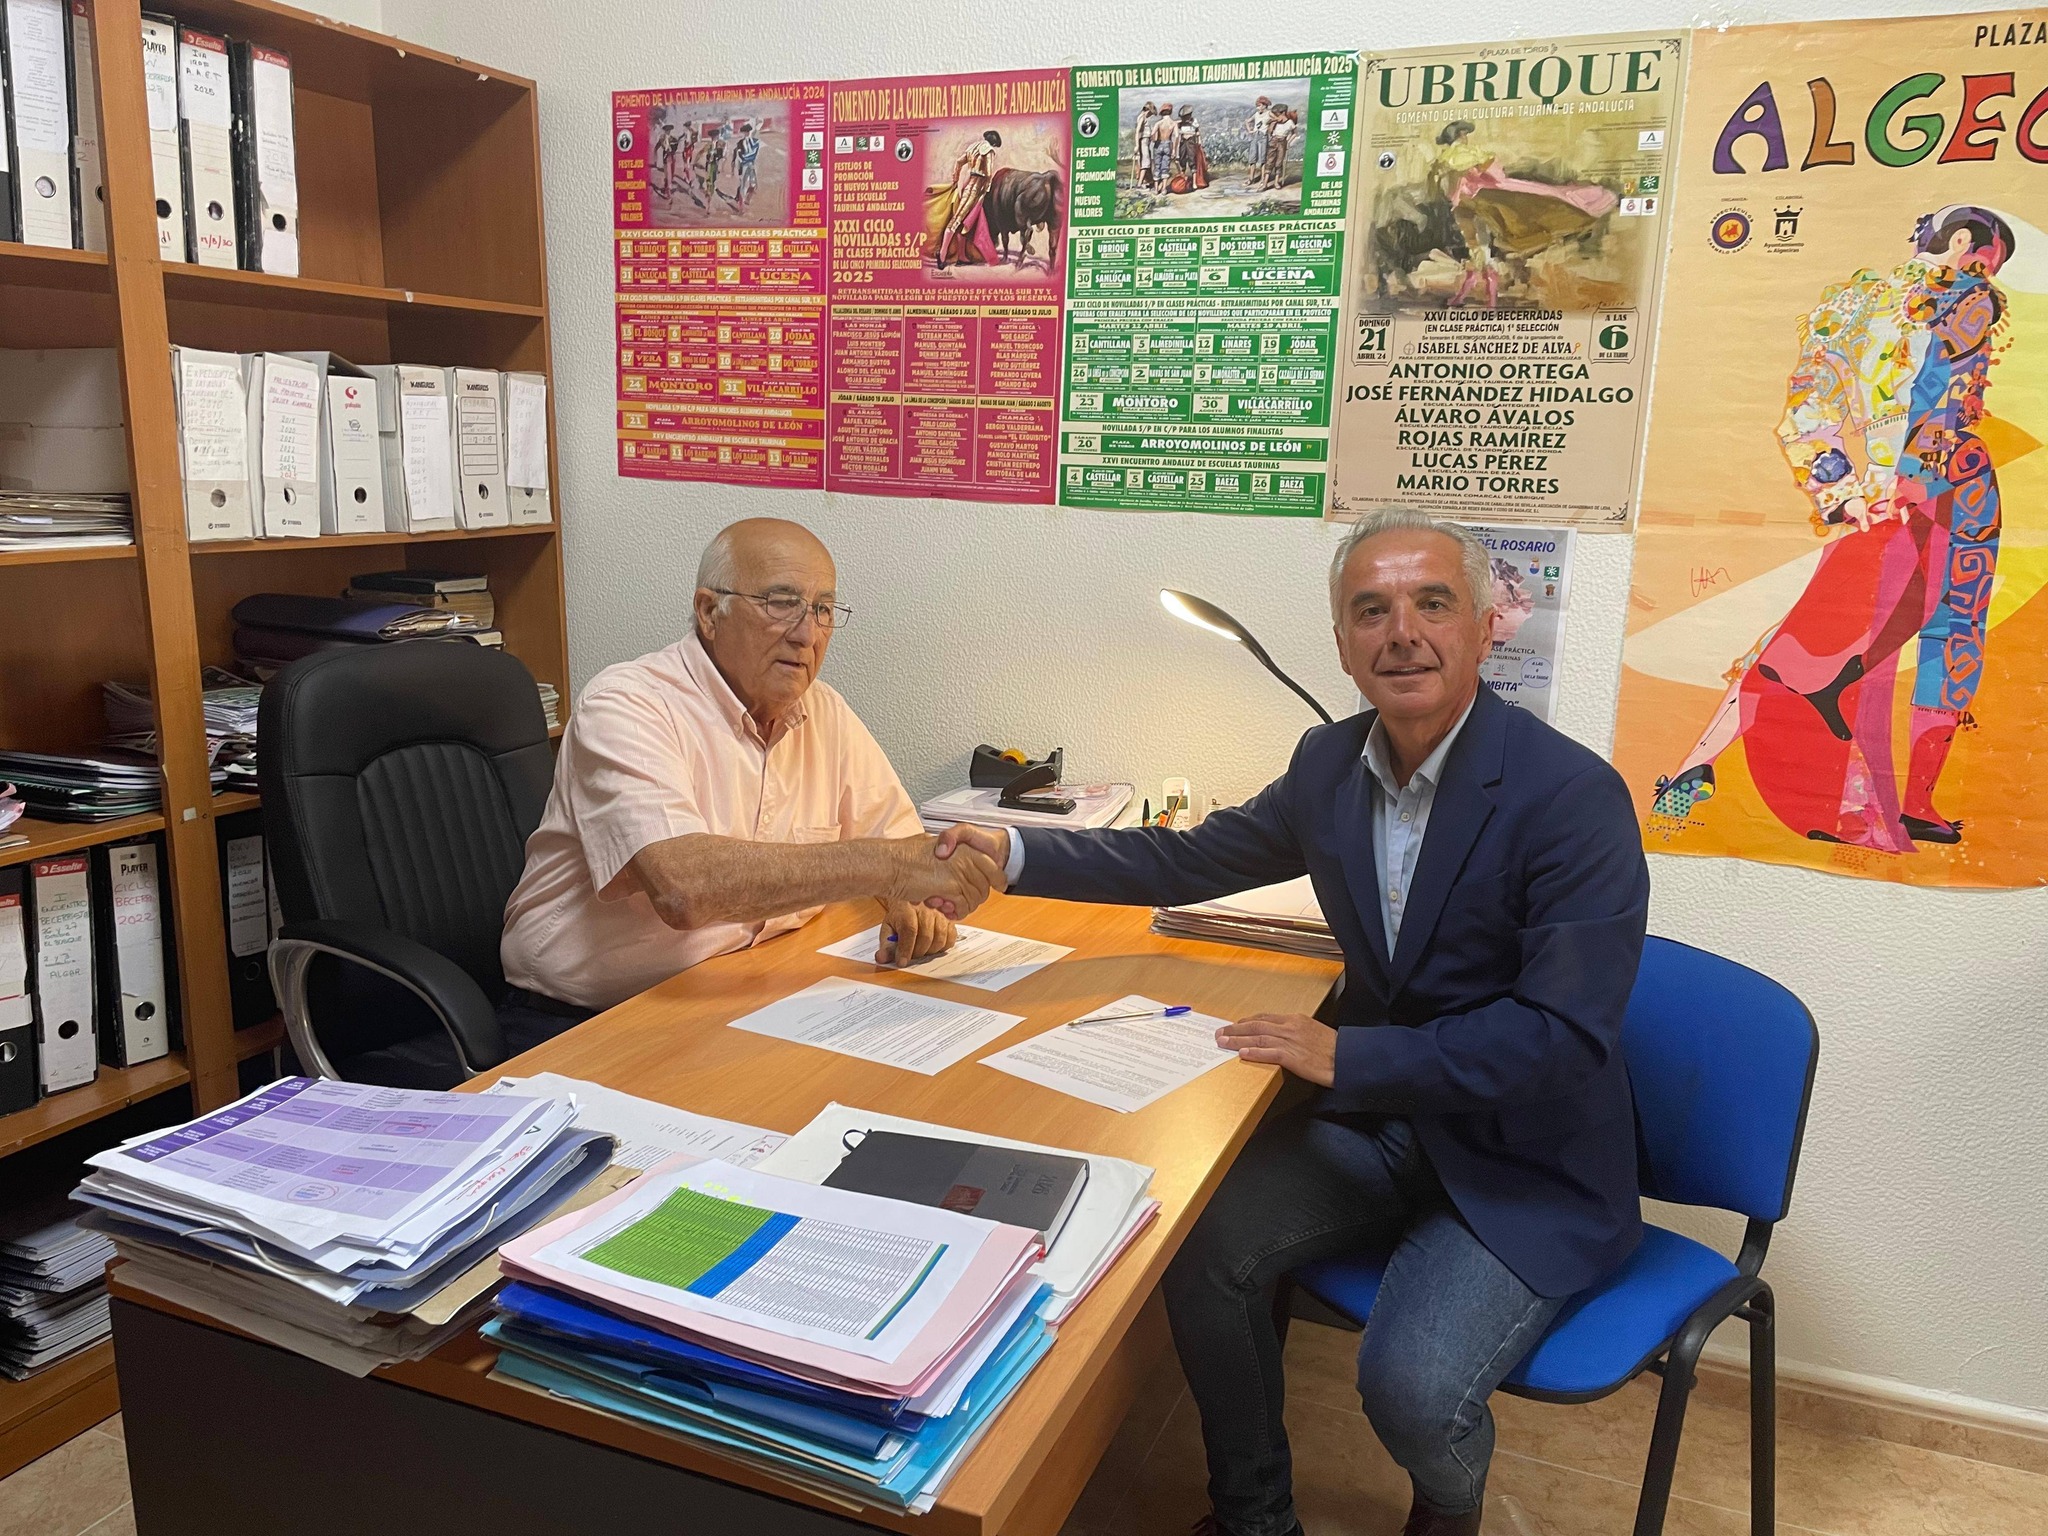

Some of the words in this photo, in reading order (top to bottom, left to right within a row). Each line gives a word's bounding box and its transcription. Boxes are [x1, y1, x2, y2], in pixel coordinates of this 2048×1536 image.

[1974, 22, 2047, 47] PLAZA
[142, 39, 167, 55] PLAYER
[196, 37, 222, 51] Esselte
[1486, 48, 1510, 56] PLAZA
[1523, 46, 1548, 54] TOROS
[264, 54, 287, 67] Esselte
[1076, 70, 1122, 88] FOMENTO
[1125, 69, 1138, 86] DE
[1140, 68, 1152, 85] LA
[1154, 66, 1200, 84] CULTURA
[1202, 62, 1245, 82] TAURINA
[1247, 61, 1260, 79] DE
[1262, 55, 1321, 78] ANDALUCÍA
[1324, 56, 1352, 74] 2025
[1377, 50, 1661, 107] UBRIQUE
[616, 94, 650, 108] FOMENTO
[652, 94, 662, 106] DE
[664, 93, 674, 105] LA
[676, 91, 710, 104] CULTURA
[712, 90, 742, 102] TAURINA
[746, 89, 755, 100] DE
[758, 84, 800, 100] ANDALUCÍA
[803, 86, 825, 99] 2024
[833, 89, 876, 123] FOMENTO
[878, 89, 890, 120] DE
[893, 88, 904, 120] LA
[906, 86, 948, 119] CULTURA
[951, 83, 992, 117] TAURINA
[994, 82, 1008, 115] DE
[1009, 70, 1066, 114] ANDALUCÍA
[1396, 111, 1438, 124] FOMENTO
[1443, 109, 1454, 120] DE
[1458, 108, 1468, 120] LA
[1472, 106, 1514, 119] CULTURA
[1518, 104, 1558, 117] TAURINA
[1562, 102, 1574, 114] DE
[1076, 147, 1109, 157] FESTEJOS
[834, 162, 862, 171] FESTEJOS
[864, 161, 872, 170] DE
[1076, 160, 1085, 169] DE
[834, 170, 874, 181] PROMOCIÓN
[1076, 168, 1116, 182] PROMOCIÓN
[1075, 184, 1084, 194] DE
[834, 203, 865, 212] TAURINAS
[866, 202, 905, 211] ANDALUZAS
[1075, 196, 1100, 206] NUEVOS
[1074, 207, 1103, 217] VALORES
[1710, 207, 1754, 224] ESPECTÁCULOS
[833, 219, 859, 233] XXXI
[863, 219, 894, 233] CICLO
[1078, 228, 1104, 236] XXVII
[1108, 227, 1134, 235] CICLO
[1154, 225, 1218, 234] BECERRADAS
[1240, 224, 1274, 232] CLASES
[1279, 221, 1336, 231] PRÁCTICAS
[833, 233, 901, 247] NOVILLADAS
[905, 232, 928, 248] S/P
[1221, 242, 1235, 250] DOS
[1236, 241, 1265, 250] TORRES
[1290, 239, 1332, 249] ALGECIRAS
[1707, 238, 1730, 254] CARMELO
[1732, 237, 1752, 253] GARCÍA
[833, 248, 843, 259] EN
[846, 248, 873, 258] CLASES
[876, 246, 920, 258] PRÁCTICAS
[1098, 244, 1129, 253] UBRIQUE
[1158, 243, 1197, 252] CASTELLAR
[751, 272, 812, 281] LUCENA
[833, 271, 873, 283] 2025
[1095, 272, 1132, 283] SANLÚCAR
[1242, 270, 1315, 280] LUCENA
[1424, 311, 1446, 321] XXVI
[1450, 311, 1478, 321] CICLO
[1481, 311, 1494, 321] DE
[1496, 310, 1562, 320] BECERRADAS
[1359, 319, 1390, 327] DOMINGO
[1425, 324, 1437, 334] (EN
[1440, 324, 1462, 332] CLASE
[1465, 322, 1505, 334] PRÁCTICA)
[1516, 322, 1559, 332] SELECCIÓN
[1359, 328, 1386, 351] 21
[1599, 325, 1628, 350] 6
[1418, 342, 1460, 354] ISABEL
[1463, 340, 1518, 354] SÁNCHEZ
[1522, 342, 1538, 354] DE
[1542, 342, 1572, 354] ALVA
[1388, 363, 1493, 379] ANTONIO
[1500, 363, 1590, 379] ORTEGA
[649, 381, 713, 391] MONTORO
[746, 384, 817, 395] VILLACARRILLO
[1346, 381, 1393, 402] JOSÉ
[1399, 381, 1523, 402] FERNÁNDEZ
[1530, 387, 1633, 403] HIDALGO
[1113, 398, 1178, 408] MONTORO
[1238, 400, 1313, 410] VILLACARRILLO
[1394, 404, 1481, 424] ÁLVARO
[1487, 404, 1575, 426] ÁVALOS
[682, 416, 760, 429] ARROYOMOLINOS
[762, 421, 775, 429] DE
[777, 419, 803, 431] LEÓN
[1398, 430, 1463, 448] ROJAS
[1470, 428, 1567, 449] RAMÍREZ
[1141, 439, 1246, 450] ARROYOMOLINOS
[1250, 441, 1266, 451] DE
[1270, 440, 1302, 452] LEÓN
[1121, 457, 1160, 465] ENCUENTRO
[1412, 453, 1478, 469] LUCAS
[1485, 450, 1548, 470] PÉREZ
[1397, 474, 1469, 490] MARIO
[1476, 476, 1559, 494] TORRES
[1501, 540, 1555, 552] ROSARIO
[50, 862, 83, 873] Esselte
[121, 863, 148, 876] PLAYER
[50, 969, 81, 979] ALGAR
